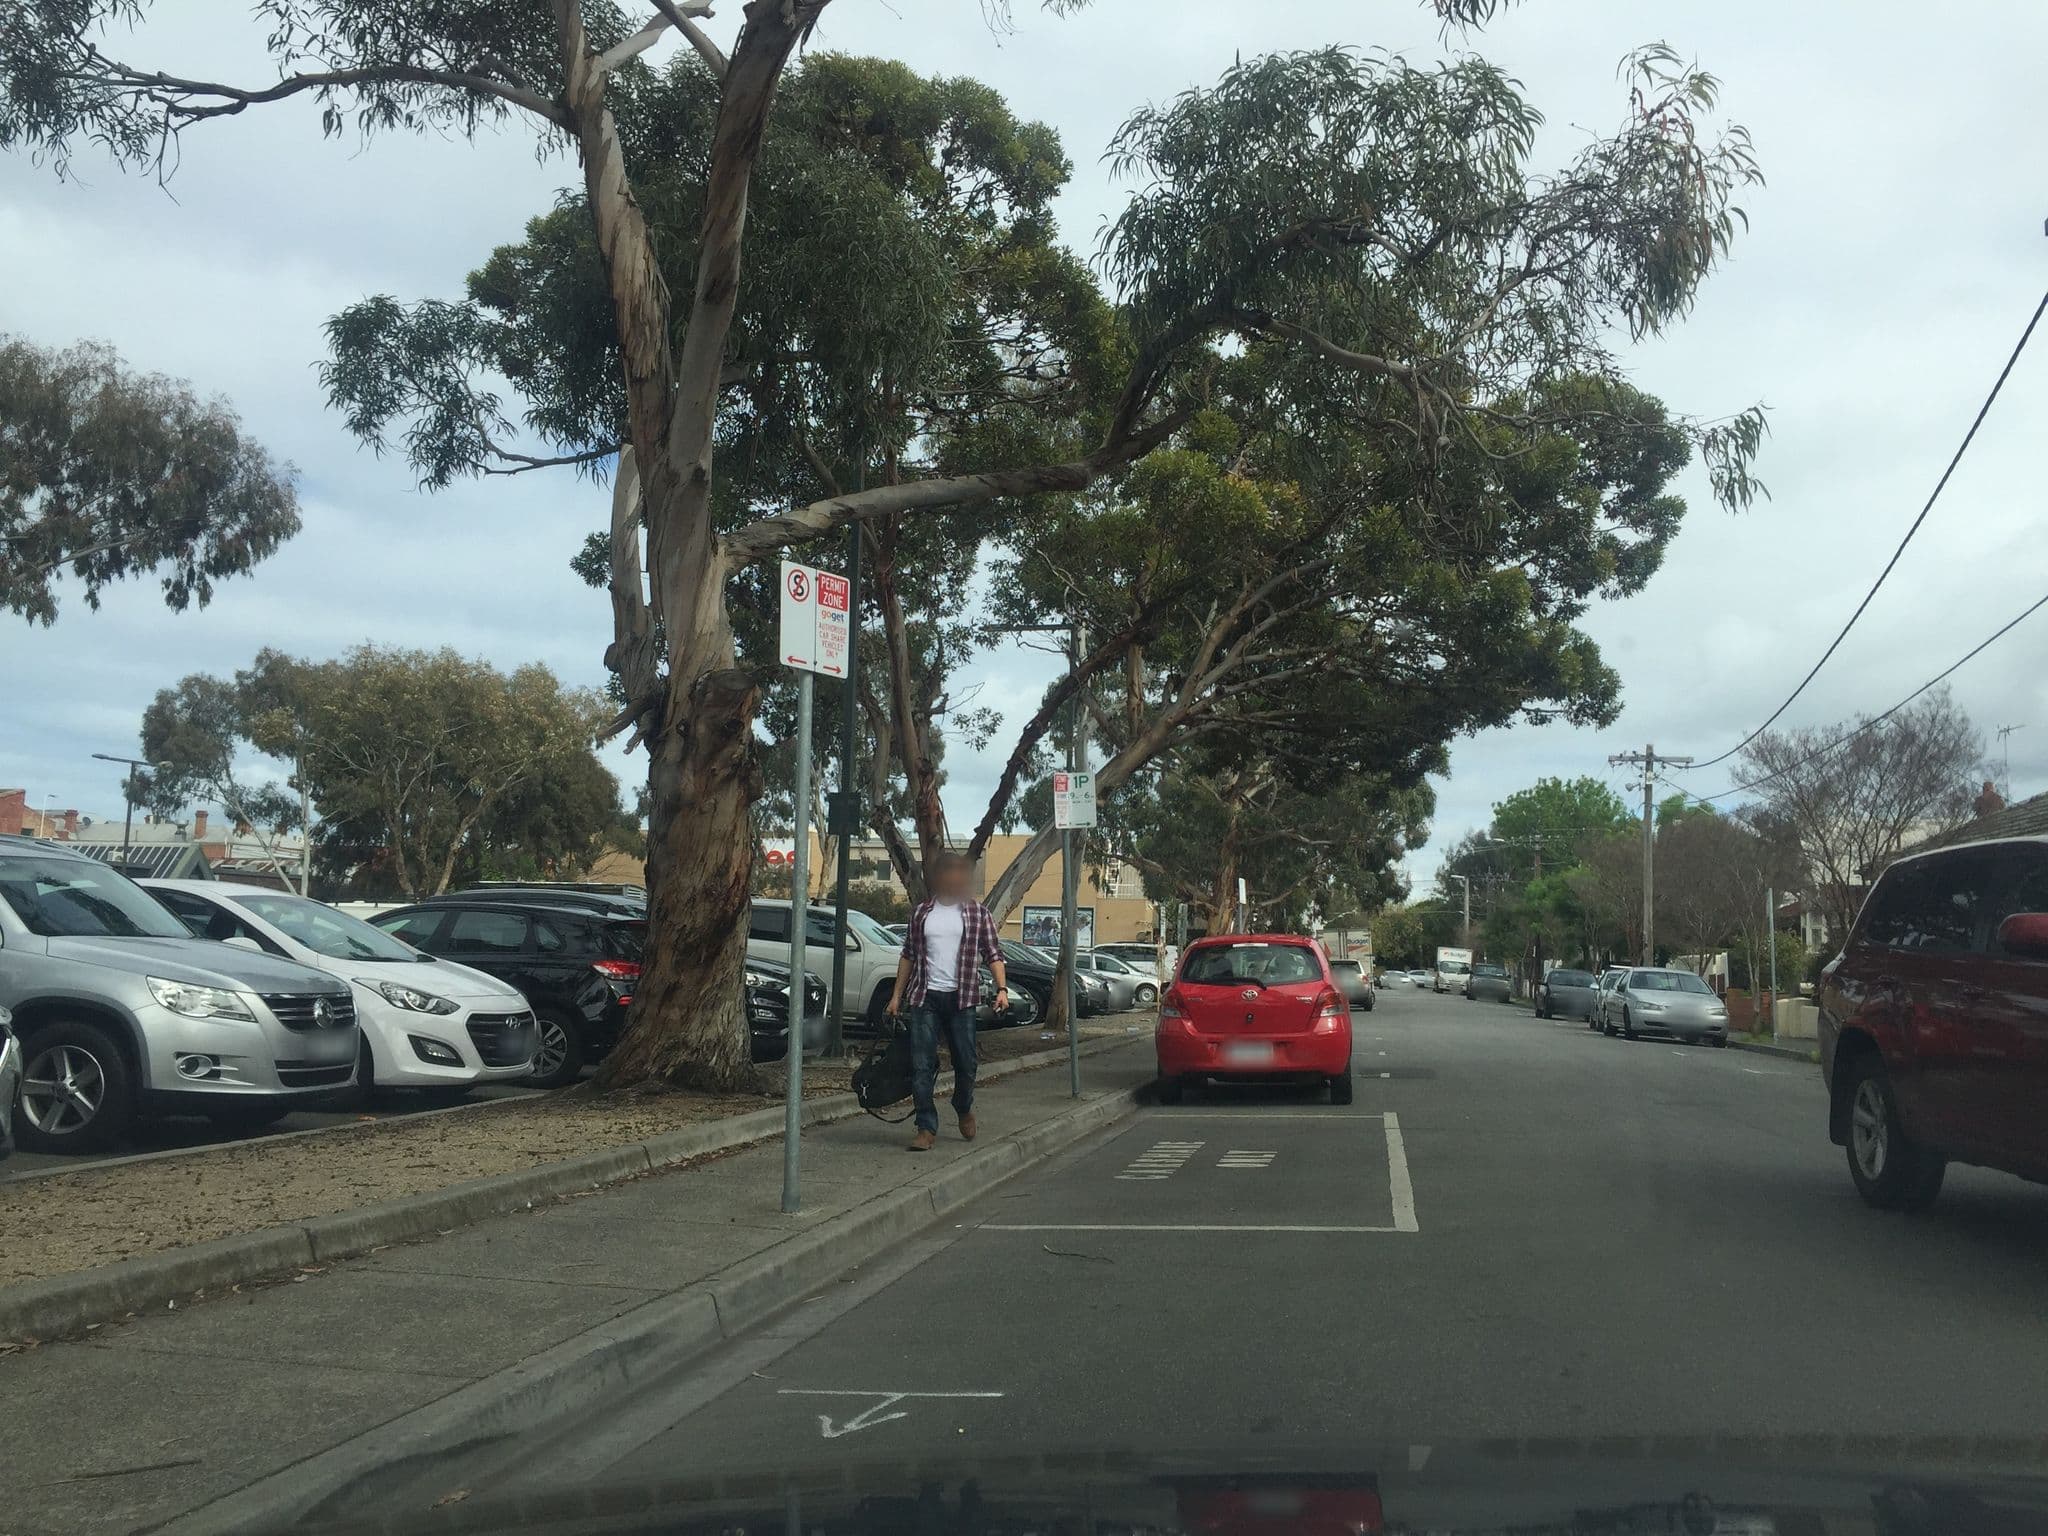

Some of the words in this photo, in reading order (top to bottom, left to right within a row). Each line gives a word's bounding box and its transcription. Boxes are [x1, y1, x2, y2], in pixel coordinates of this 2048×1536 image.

[821, 576, 845, 594] PERMIT
[823, 591, 843, 608] ZONE
[821, 610, 844, 622] goget
[1073, 775, 1089, 788] 1P
